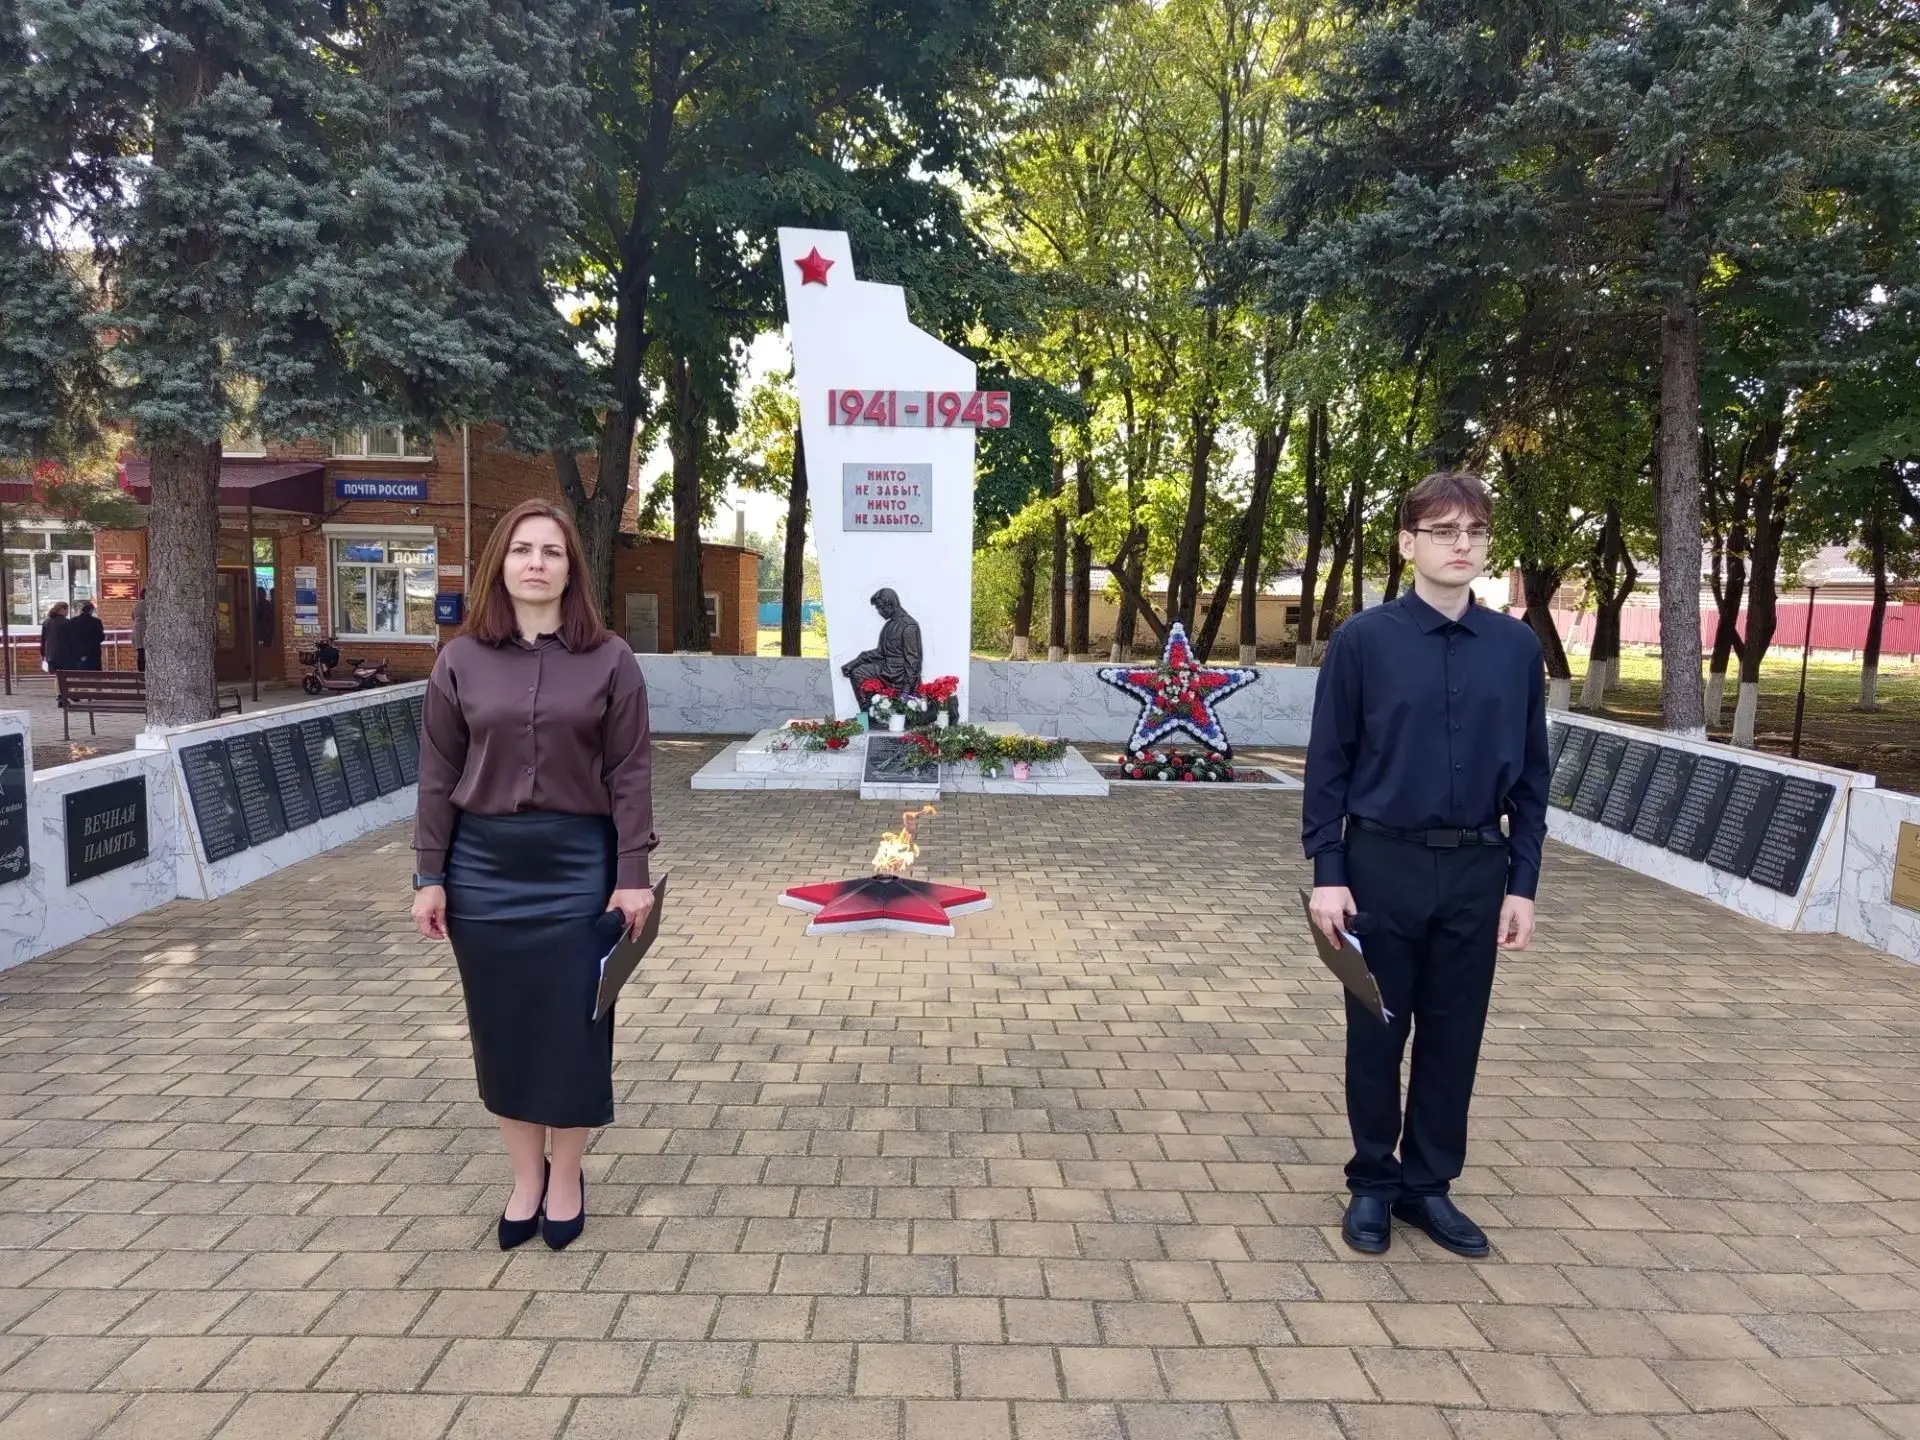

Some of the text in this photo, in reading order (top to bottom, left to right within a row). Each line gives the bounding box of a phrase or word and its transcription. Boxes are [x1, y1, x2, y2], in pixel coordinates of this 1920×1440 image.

[867, 470, 907, 482] НИКТО
[344, 484, 418, 496] ПОЧТА РОССИИ
[855, 485, 869, 496] НЕ
[867, 499, 907, 511] НИЧТО
[855, 513, 869, 525] НЕ
[83, 803, 137, 837] ВЕЧНАЯ
[83, 831, 137, 863] ПАМЯТЬ
